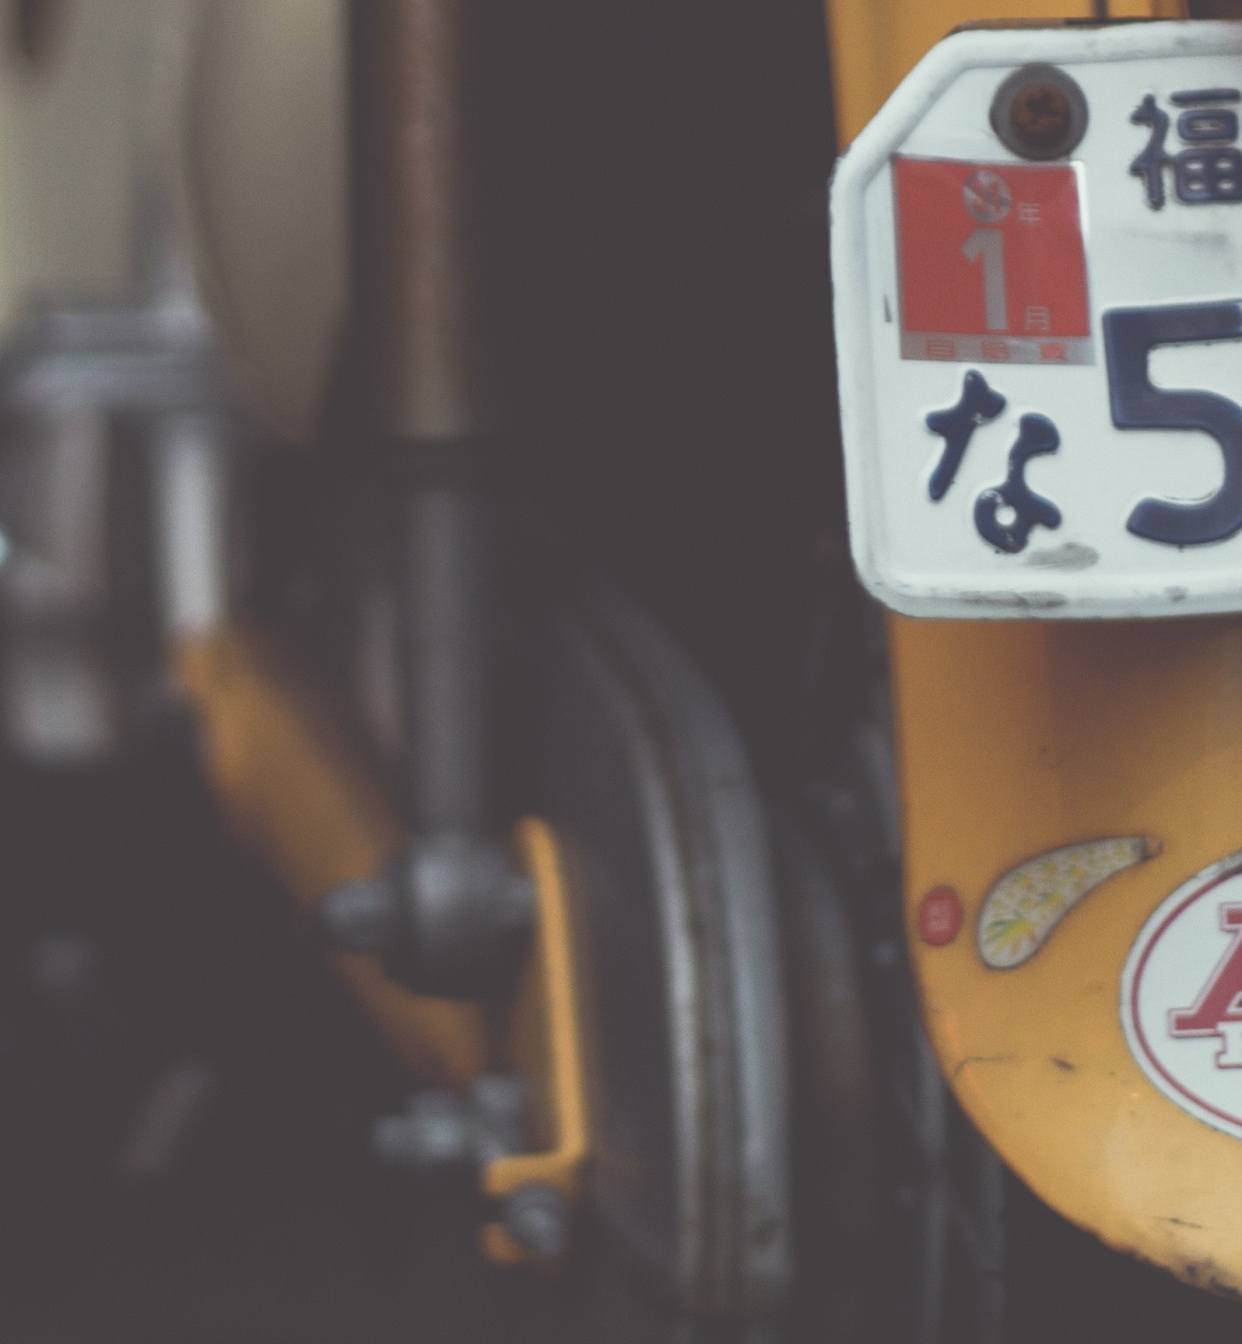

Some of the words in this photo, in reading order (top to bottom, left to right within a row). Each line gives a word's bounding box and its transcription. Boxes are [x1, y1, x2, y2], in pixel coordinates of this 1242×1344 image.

[1129, 88, 1242, 210] 福
[1018, 202, 1043, 226] 年
[961, 227, 1009, 330] 1
[1024, 306, 1049, 331] 月
[926, 370, 1062, 554] な
[1102, 298, 1242, 548] 5
